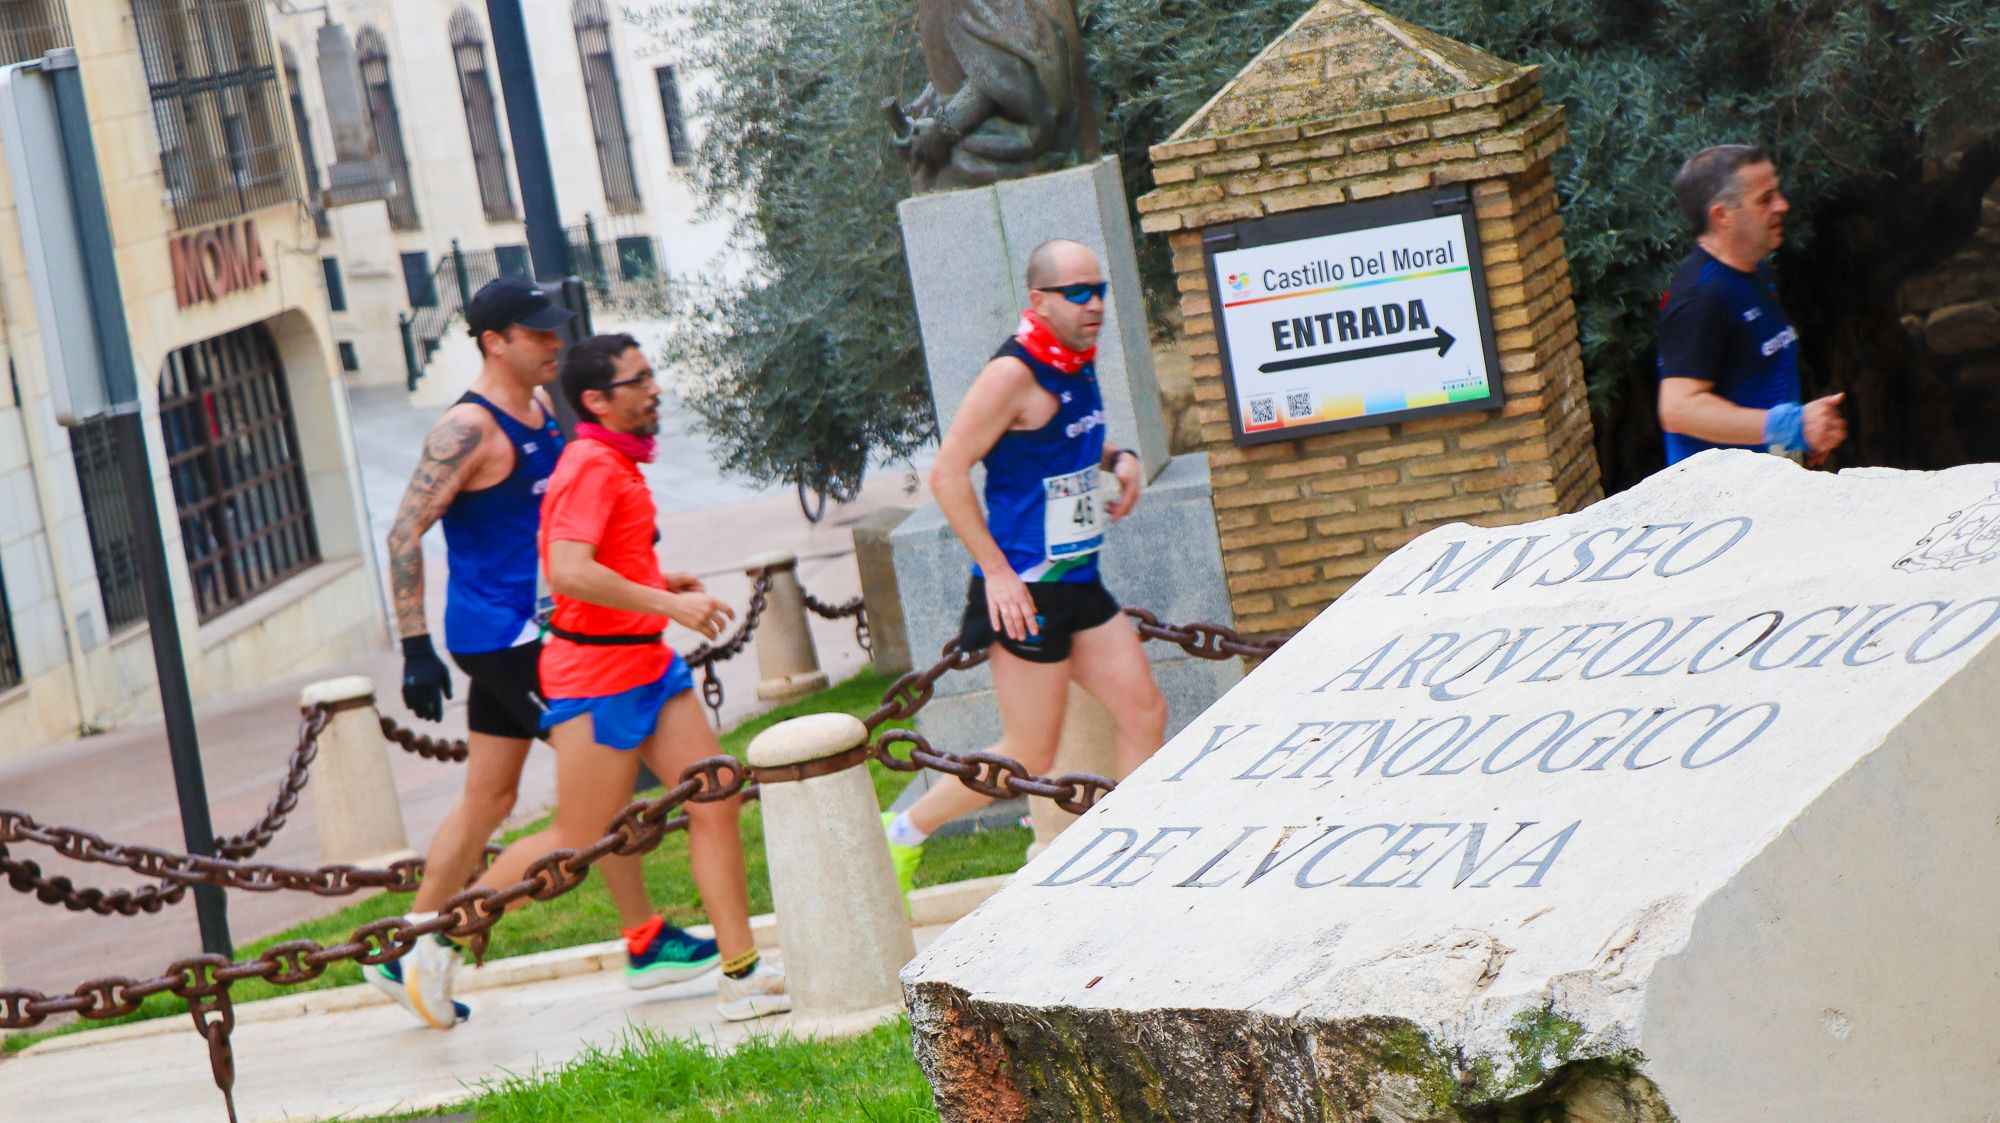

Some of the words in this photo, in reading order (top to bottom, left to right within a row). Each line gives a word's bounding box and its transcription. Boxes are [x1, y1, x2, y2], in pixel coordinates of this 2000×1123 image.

[168, 219, 271, 309] MOMA
[1262, 259, 1345, 292] Castillo
[1350, 250, 1387, 279] Del
[1391, 239, 1455, 272] Moral
[1271, 298, 1432, 352] ENTRADA
[1385, 516, 1753, 597] MVSEO
[1314, 595, 2000, 701] ARQVEOLOGICO
[1161, 723, 1261, 782] Y
[1231, 701, 1781, 780] ETNOLOGICO
[1032, 826, 1203, 889] DE
[1171, 820, 1582, 889] LVCENA
